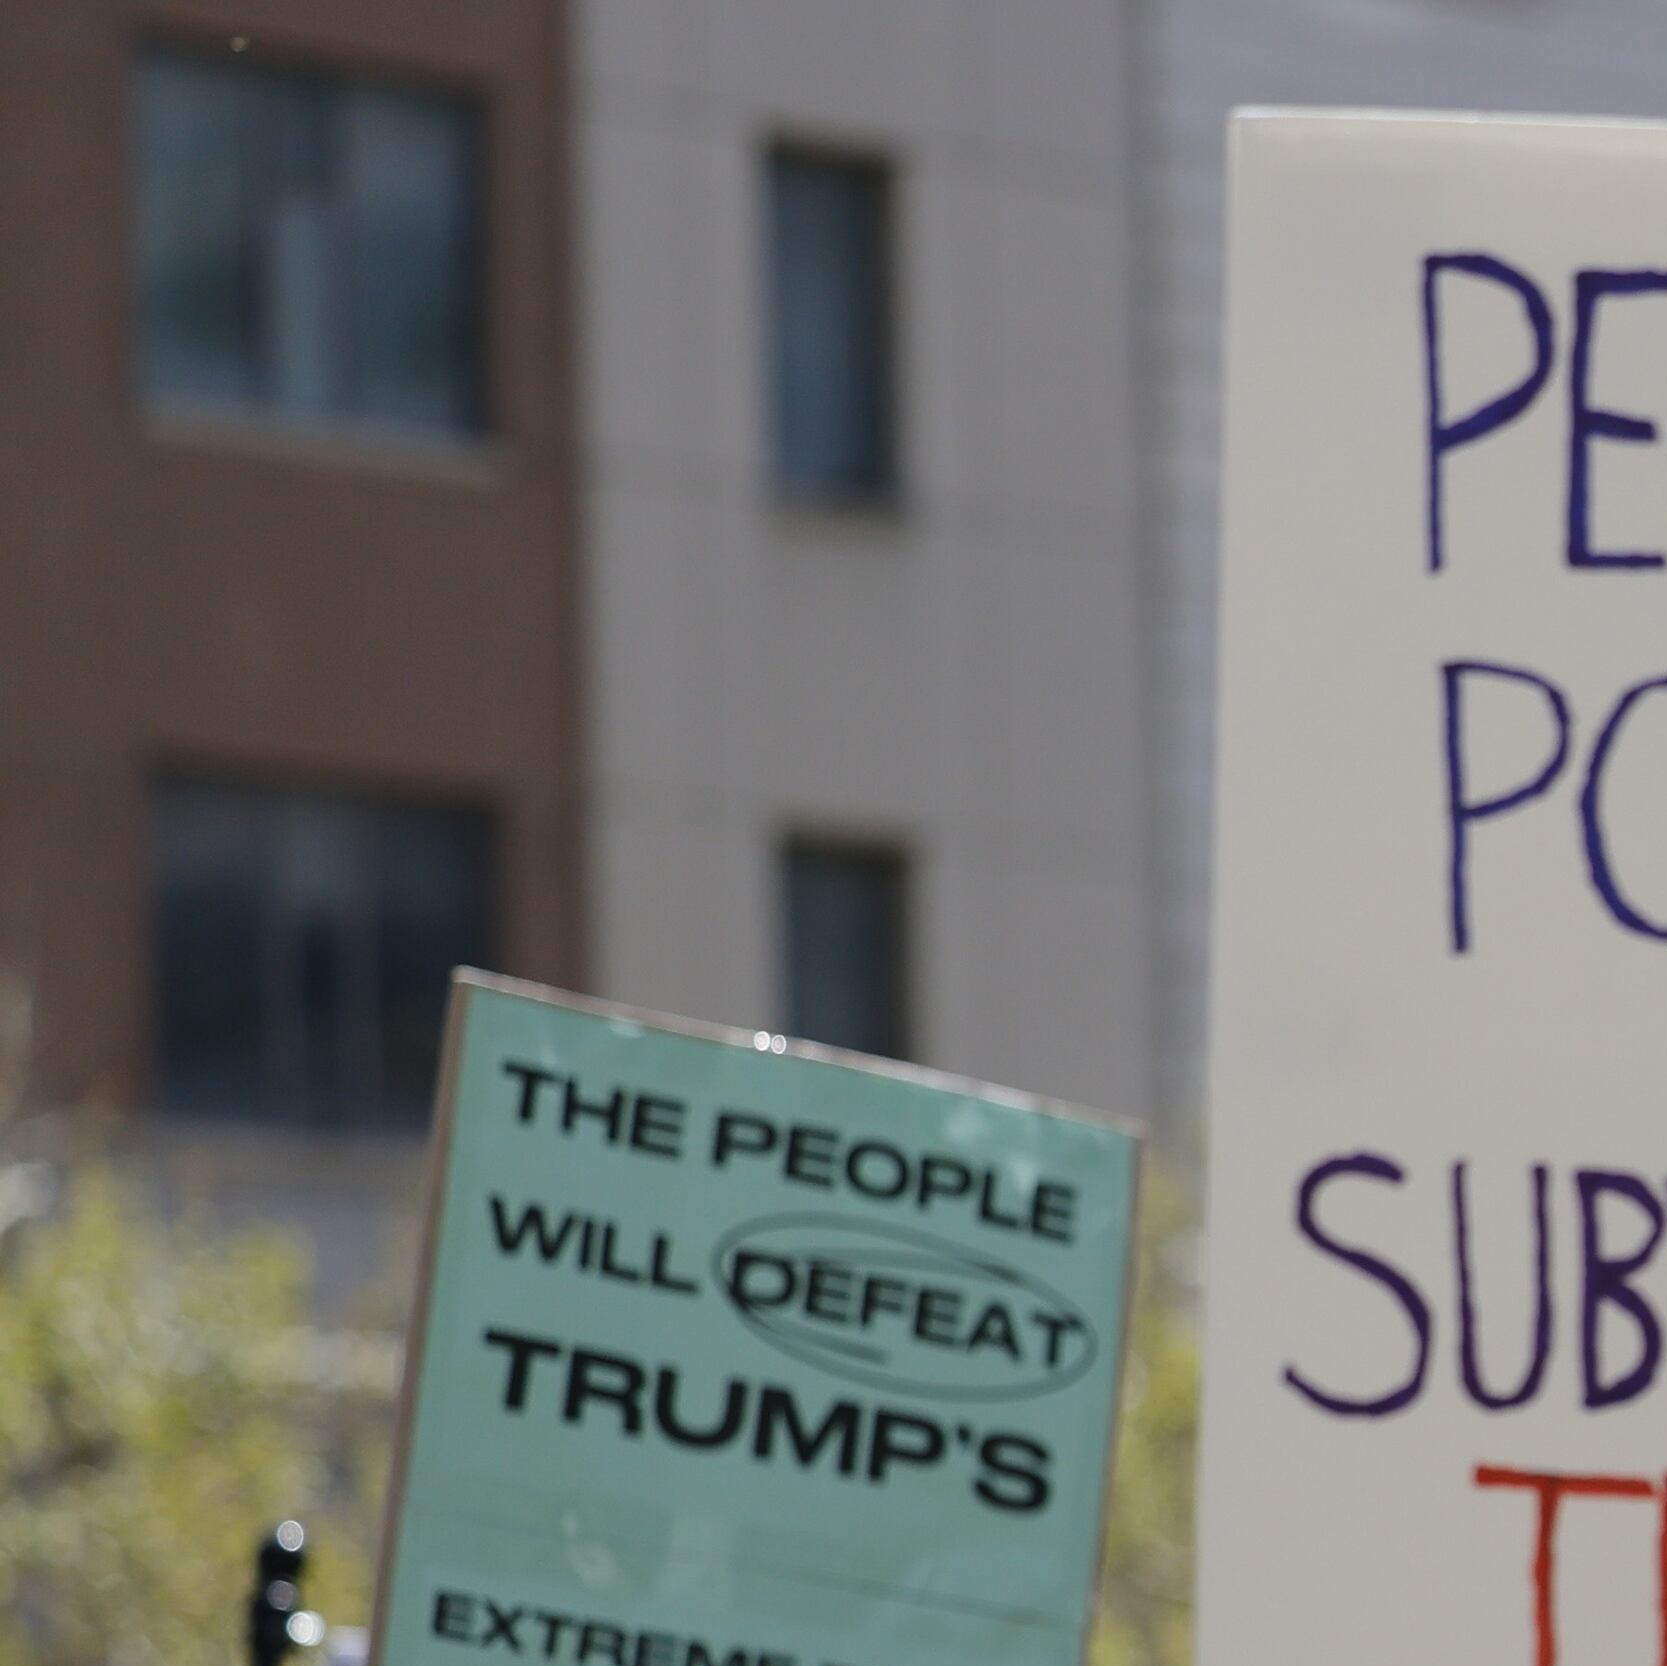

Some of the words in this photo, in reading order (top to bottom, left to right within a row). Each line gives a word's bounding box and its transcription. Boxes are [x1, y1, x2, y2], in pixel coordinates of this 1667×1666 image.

[503, 1060, 685, 1158] THE
[711, 1110, 1076, 1244] PEOPLE
[488, 1195, 700, 1296] WILL
[727, 1250, 1085, 1372] DEFEAT
[484, 1327, 1054, 1516] TRUMP'S
